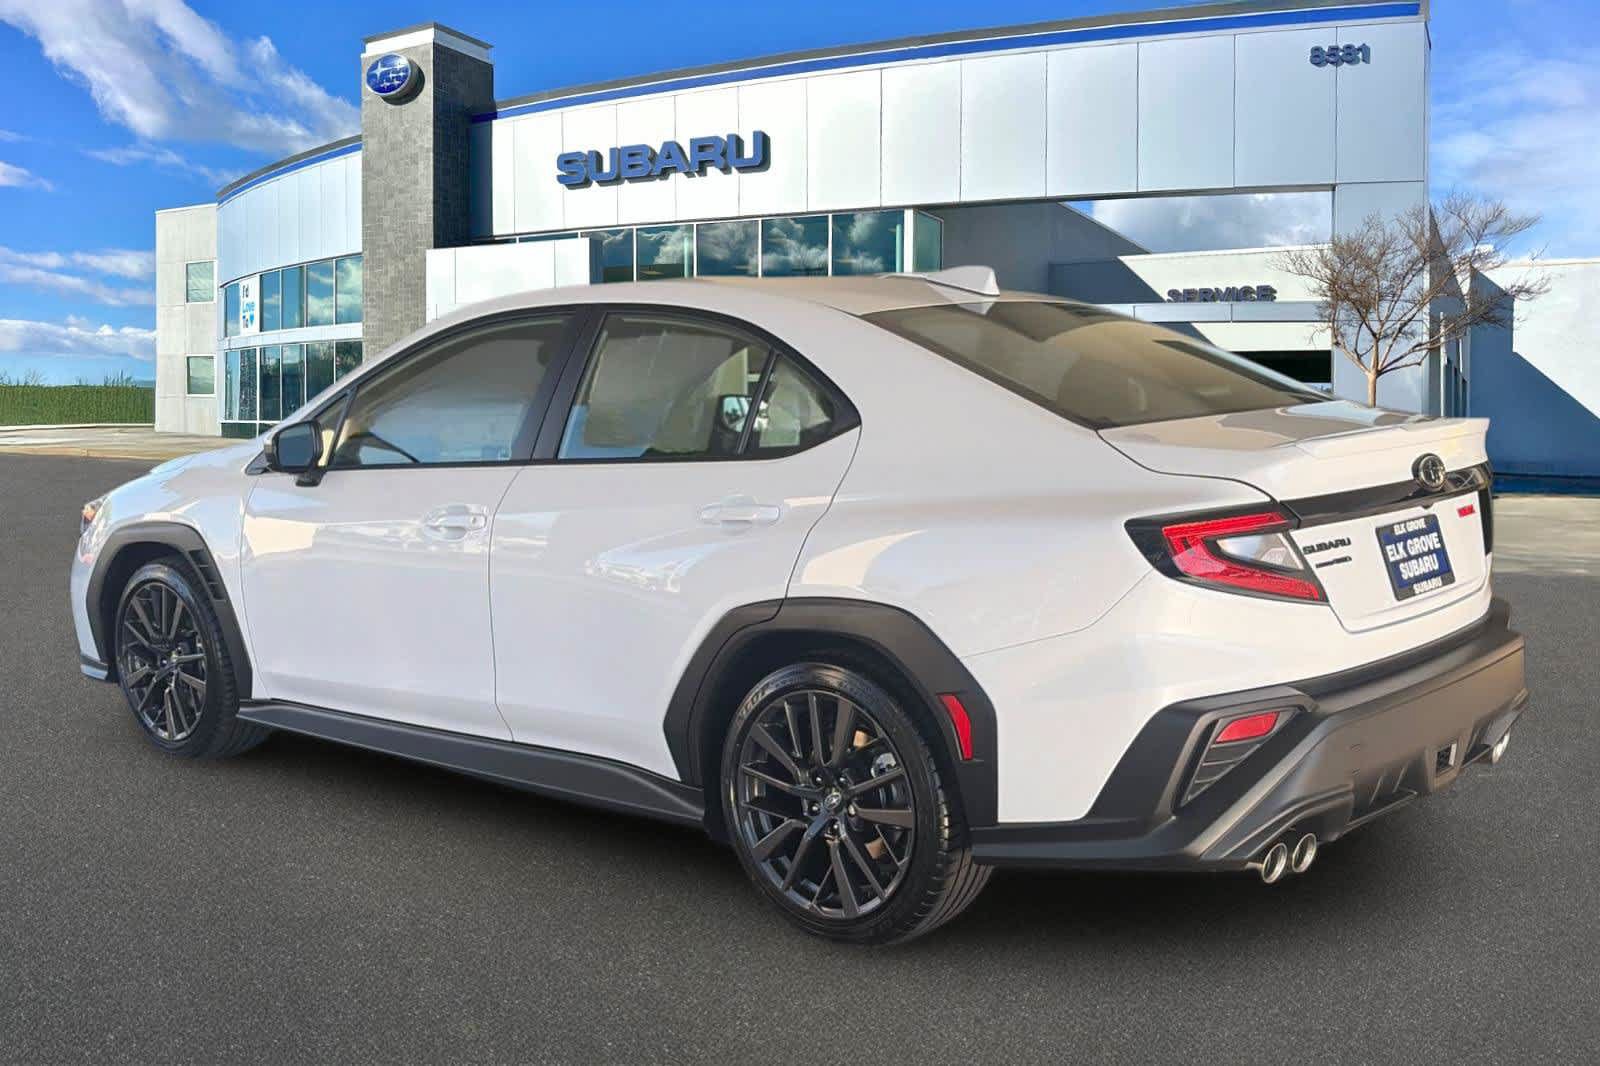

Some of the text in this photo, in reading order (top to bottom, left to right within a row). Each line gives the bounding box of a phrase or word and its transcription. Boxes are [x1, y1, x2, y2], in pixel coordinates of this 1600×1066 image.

[556, 130, 771, 190] SUBARU
[1167, 285, 1277, 302] SERVICE
[1302, 537, 1352, 555] SUBARU
[1385, 532, 1440, 562] ELK GROVE
[1399, 553, 1440, 580] SUBARU
[1413, 576, 1442, 594] SUBARU
